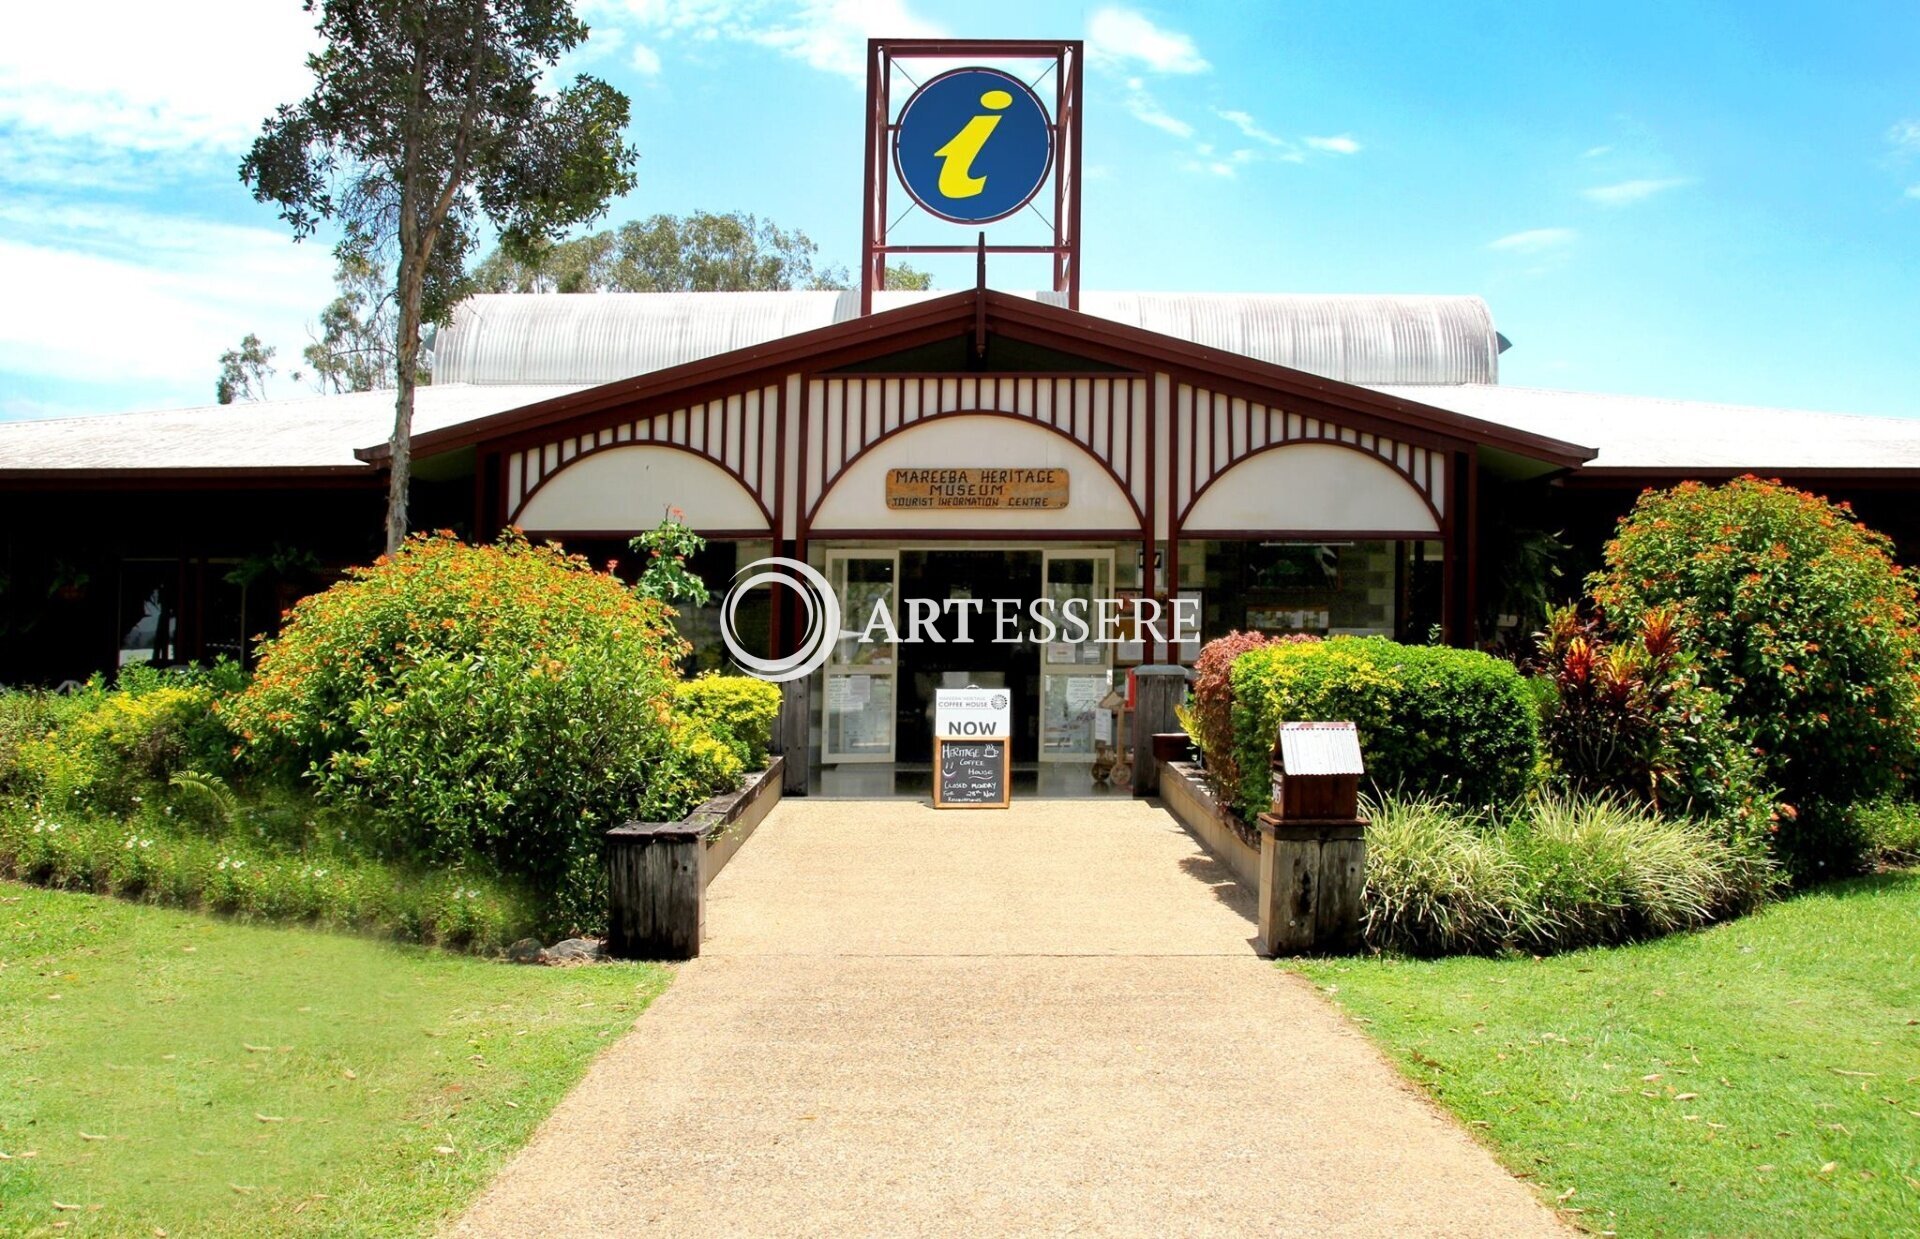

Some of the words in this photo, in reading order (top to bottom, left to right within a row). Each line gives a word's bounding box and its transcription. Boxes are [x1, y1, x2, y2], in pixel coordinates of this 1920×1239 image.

[896, 470, 968, 484] MAREEBA
[981, 470, 1055, 484] HERITAGE
[929, 485, 1004, 496] MUSEUM
[893, 497, 933, 507] TOURIST
[938, 497, 999, 507] INFORMATION
[1008, 497, 1049, 507] CENTRE
[948, 721, 997, 735] NOW
